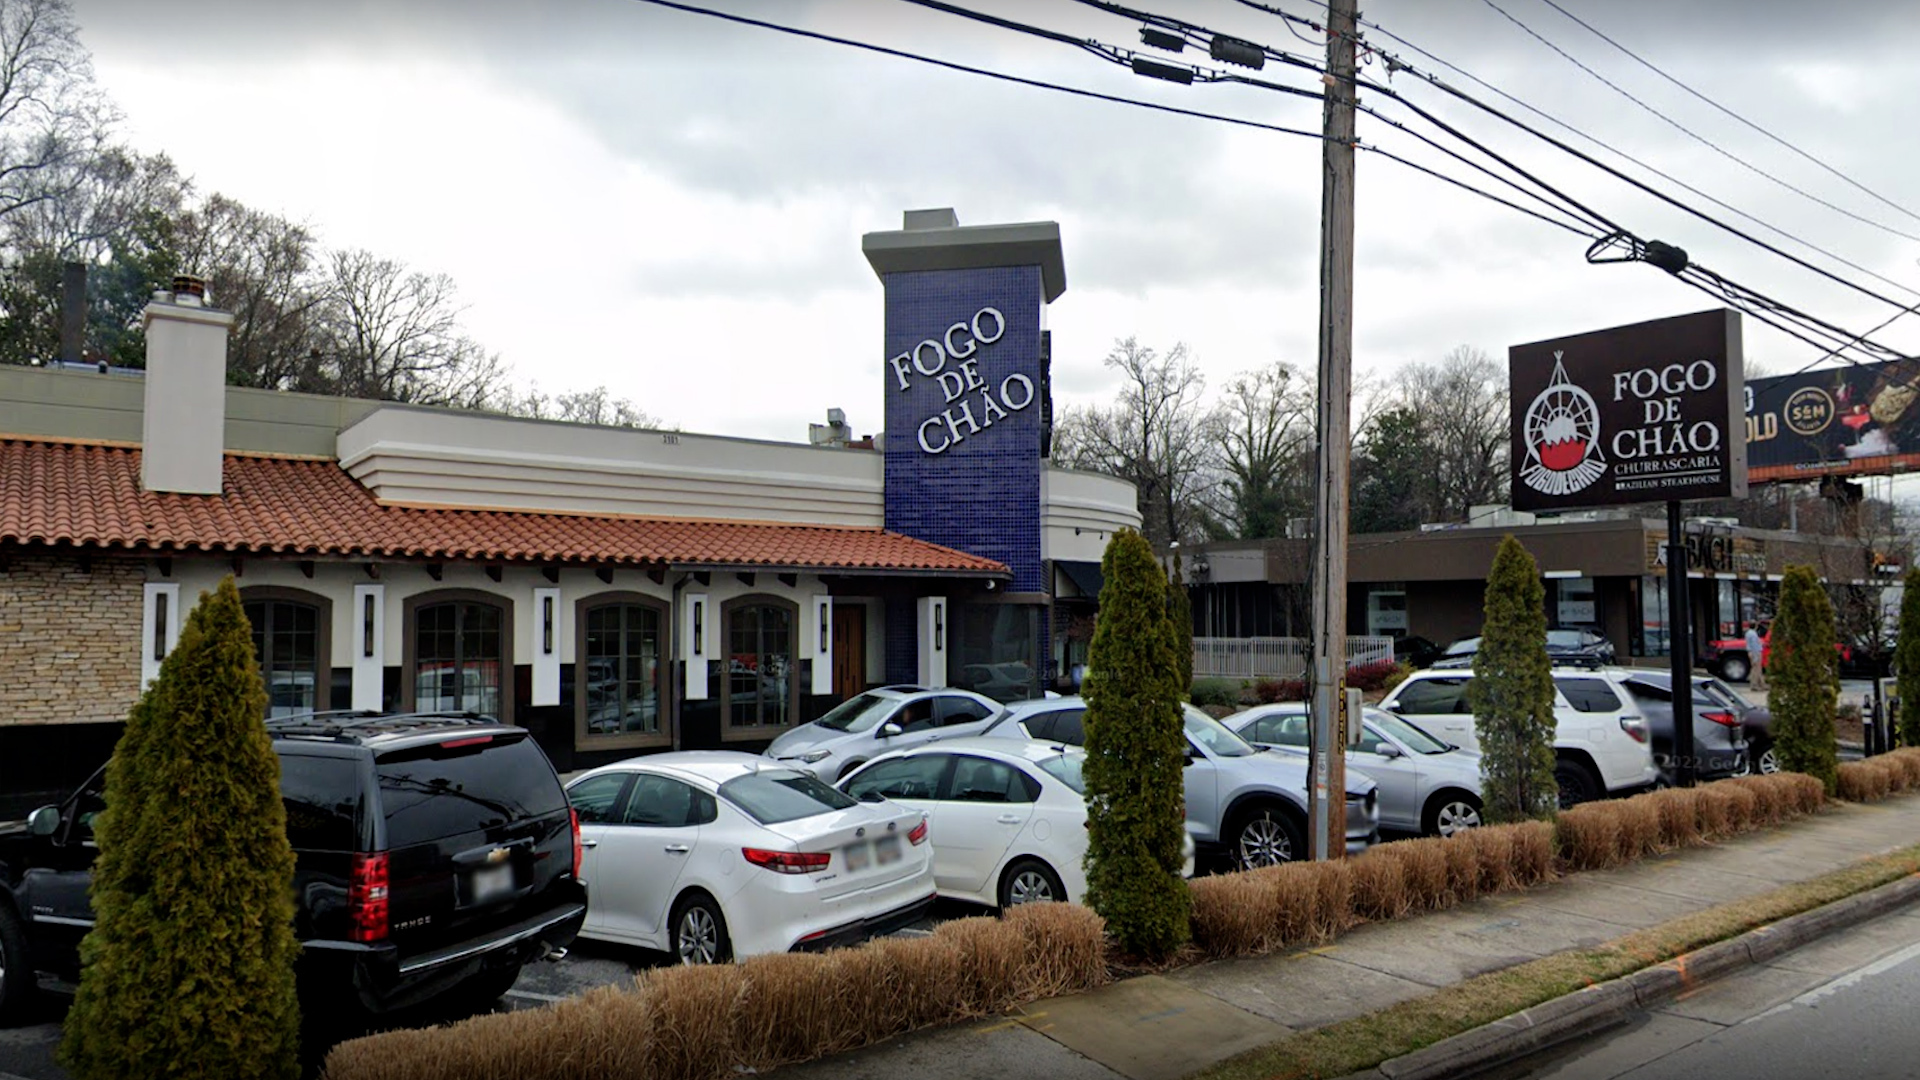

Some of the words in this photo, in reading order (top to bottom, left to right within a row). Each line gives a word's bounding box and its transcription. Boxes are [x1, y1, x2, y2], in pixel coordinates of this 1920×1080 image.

[890, 307, 1006, 391] FOGO
[936, 358, 984, 403] DE
[1613, 359, 1716, 401] FOGO
[917, 373, 1035, 454] CHÃO
[1644, 396, 1681, 424] DE
[1793, 404, 1825, 420] S&M
[1612, 421, 1719, 459] CHÃO
[1614, 456, 1720, 475] CHURRASCARIA
[1615, 480, 1658, 491] BRAZILIAN
[1661, 475, 1720, 488] STEAKHOUSE
